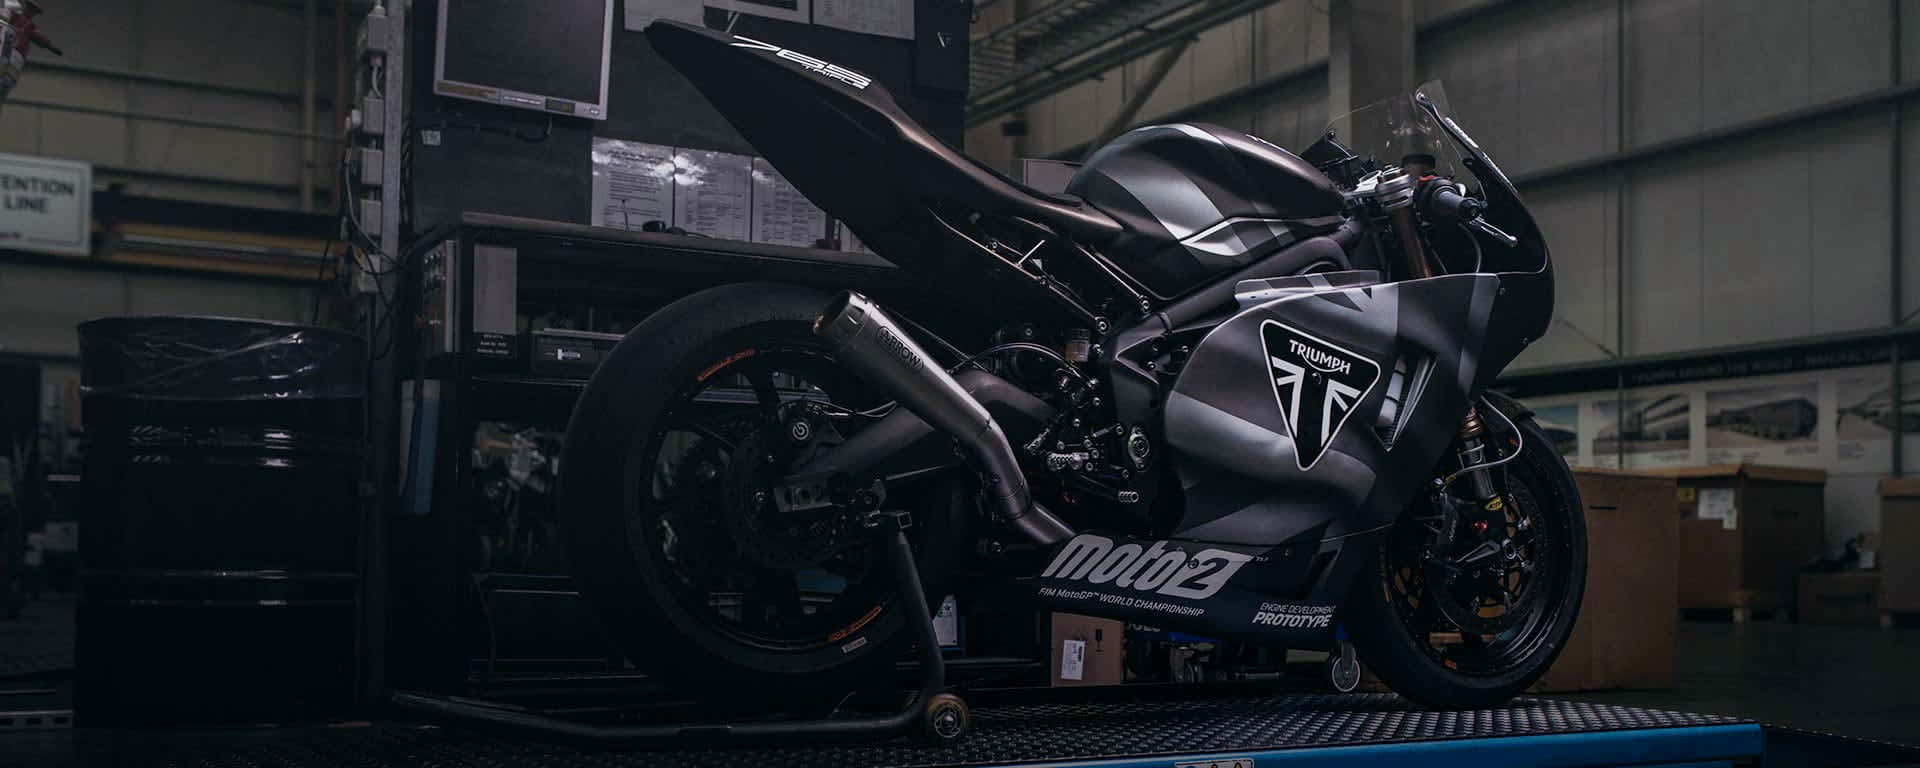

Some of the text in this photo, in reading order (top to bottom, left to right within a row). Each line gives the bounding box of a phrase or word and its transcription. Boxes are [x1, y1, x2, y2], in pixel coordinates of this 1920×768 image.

[0, 173, 75, 198] ENTION
[4, 194, 48, 214] LINE
[1289, 339, 1351, 375] TRIUMPH
[1038, 587, 1056, 597] FIM
[1099, 593, 1133, 606] WORLD
[1134, 599, 1204, 617] CHAMPIONSHIP
[1260, 602, 1336, 614] ENGINE DEVELOPMENT
[1252, 611, 1332, 628] PROTOTYPE
